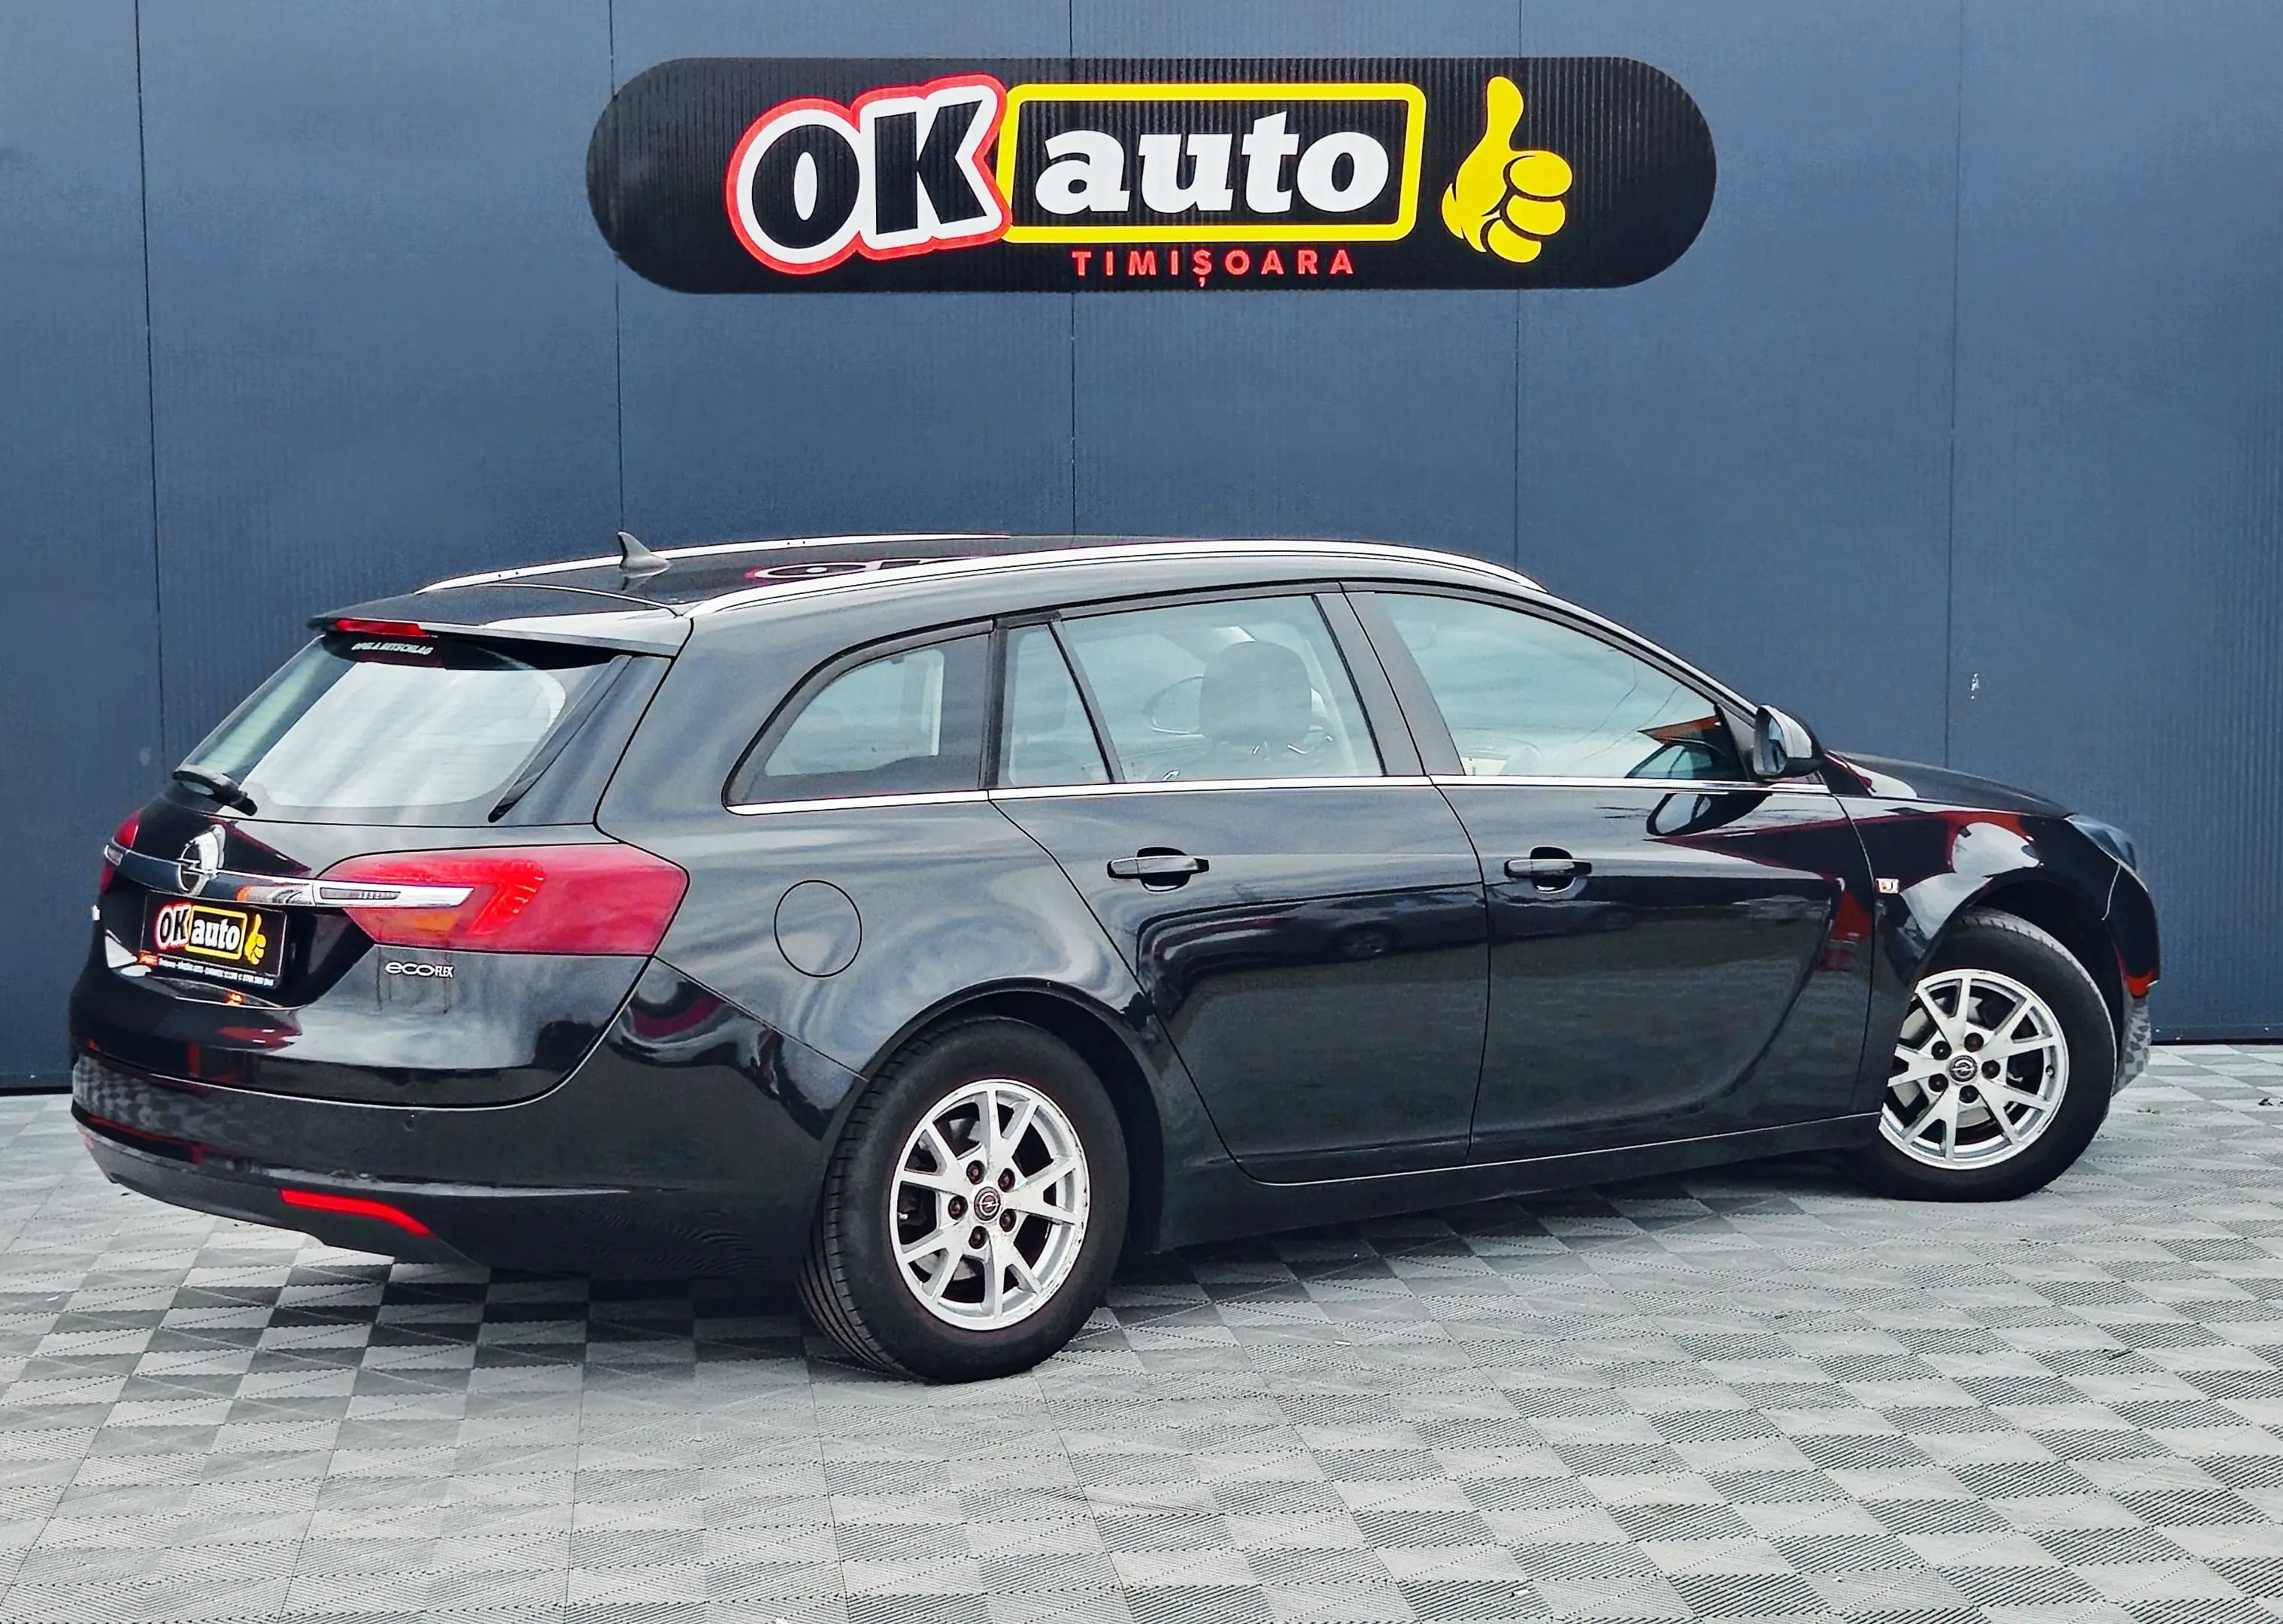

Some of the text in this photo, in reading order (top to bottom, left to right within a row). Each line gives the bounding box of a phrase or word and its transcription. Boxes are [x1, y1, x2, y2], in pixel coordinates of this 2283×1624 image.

[741, 89, 1390, 260] OK auto
[1071, 249, 1354, 288] TIMIȘOARA
[157, 905, 241, 951] OK auto
